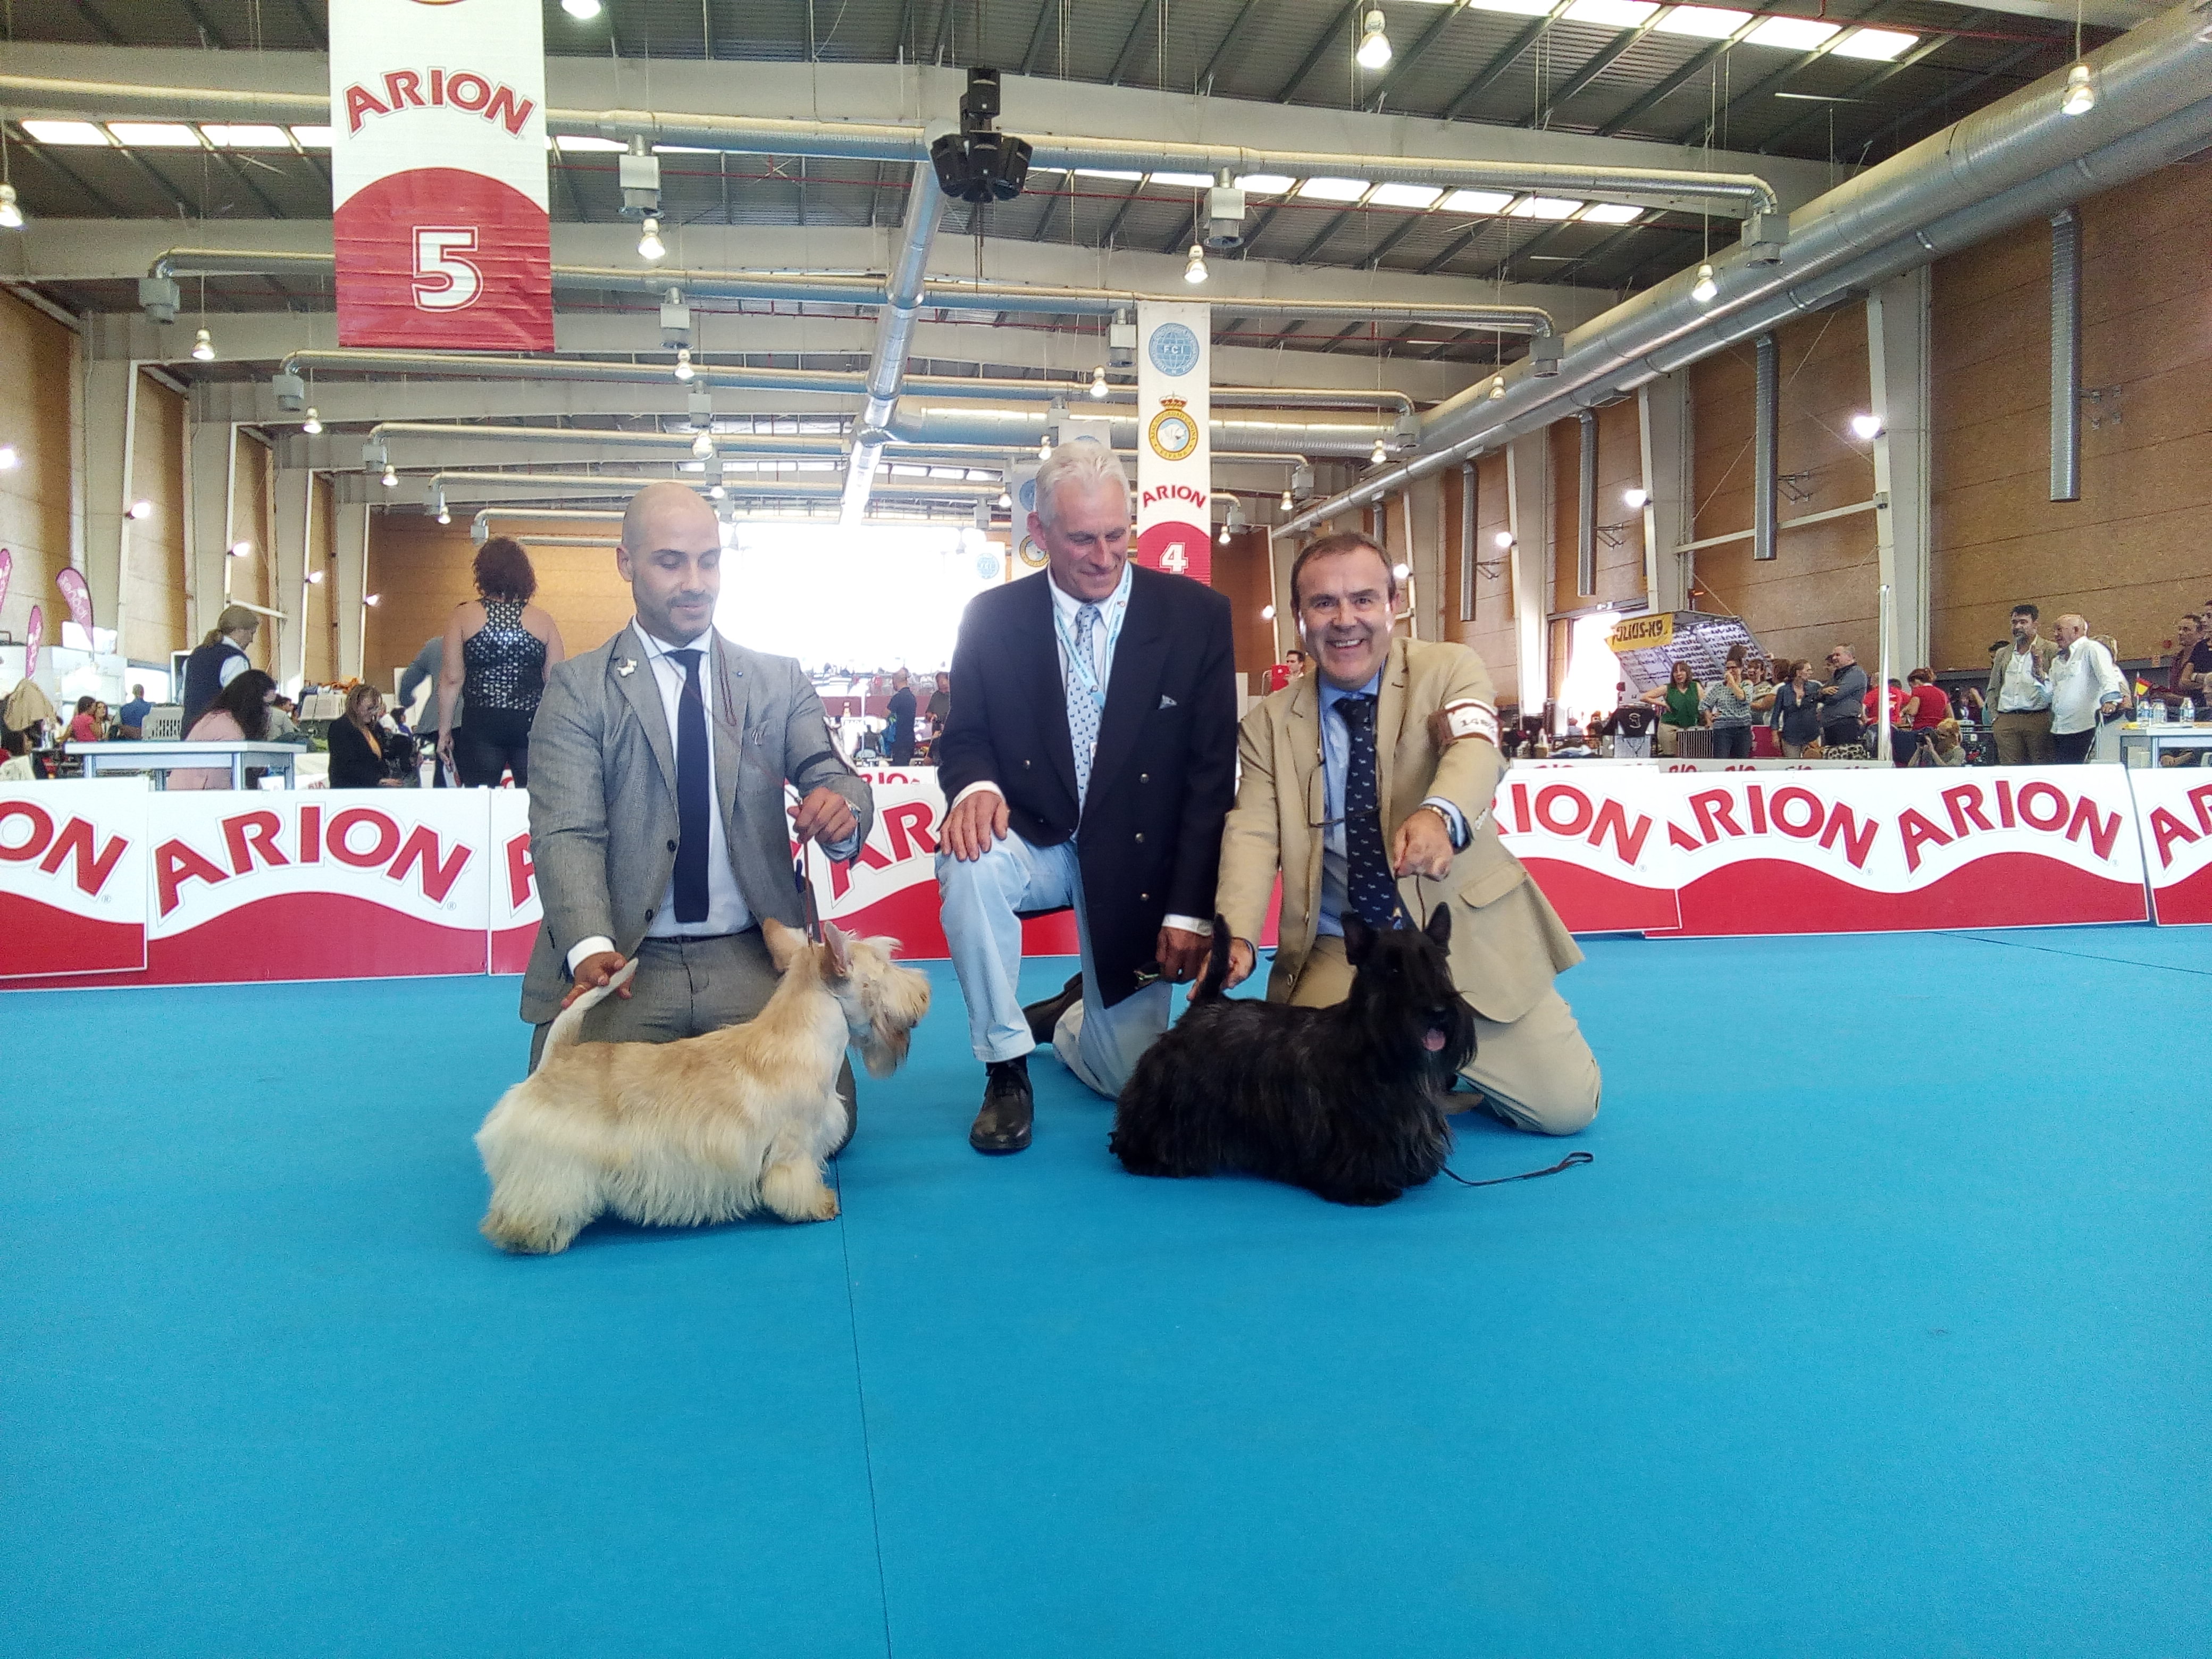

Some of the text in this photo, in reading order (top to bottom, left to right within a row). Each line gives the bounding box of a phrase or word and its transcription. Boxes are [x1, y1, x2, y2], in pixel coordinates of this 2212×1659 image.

[346, 69, 535, 136] ARION
[415, 228, 481, 311] 5
[1163, 345, 1184, 355] FCI
[1142, 484, 1207, 509] ARION
[1159, 542, 1188, 574] 4
[155, 806, 472, 918] ARION
[1492, 783, 1653, 866] ION
[1898, 780, 2122, 874] ARION
